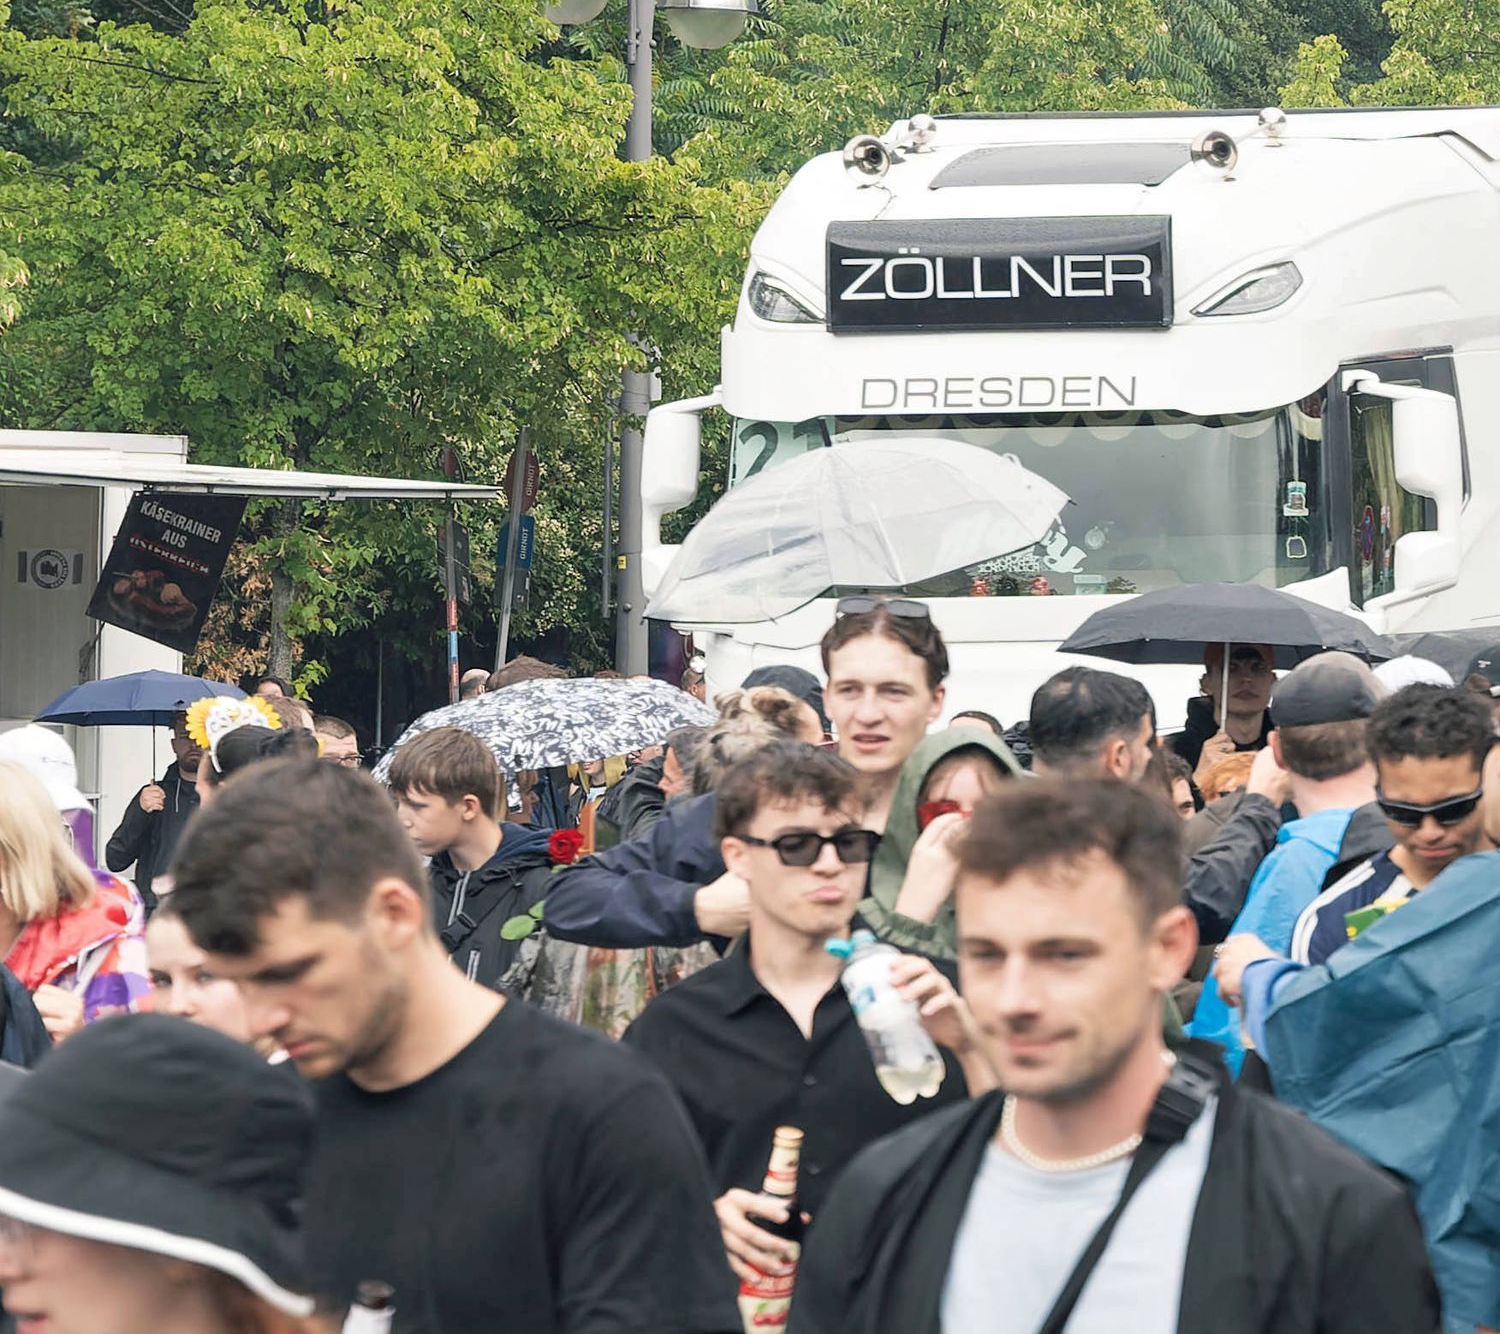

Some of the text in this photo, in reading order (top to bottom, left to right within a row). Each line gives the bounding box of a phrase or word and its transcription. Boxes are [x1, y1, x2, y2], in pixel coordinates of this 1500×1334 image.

[839, 246, 1153, 301] ZÖLLNER
[861, 376, 1137, 409] DRESDEN
[140, 499, 222, 544] KÄSEKRAINER
[161, 529, 188, 548] AUS
